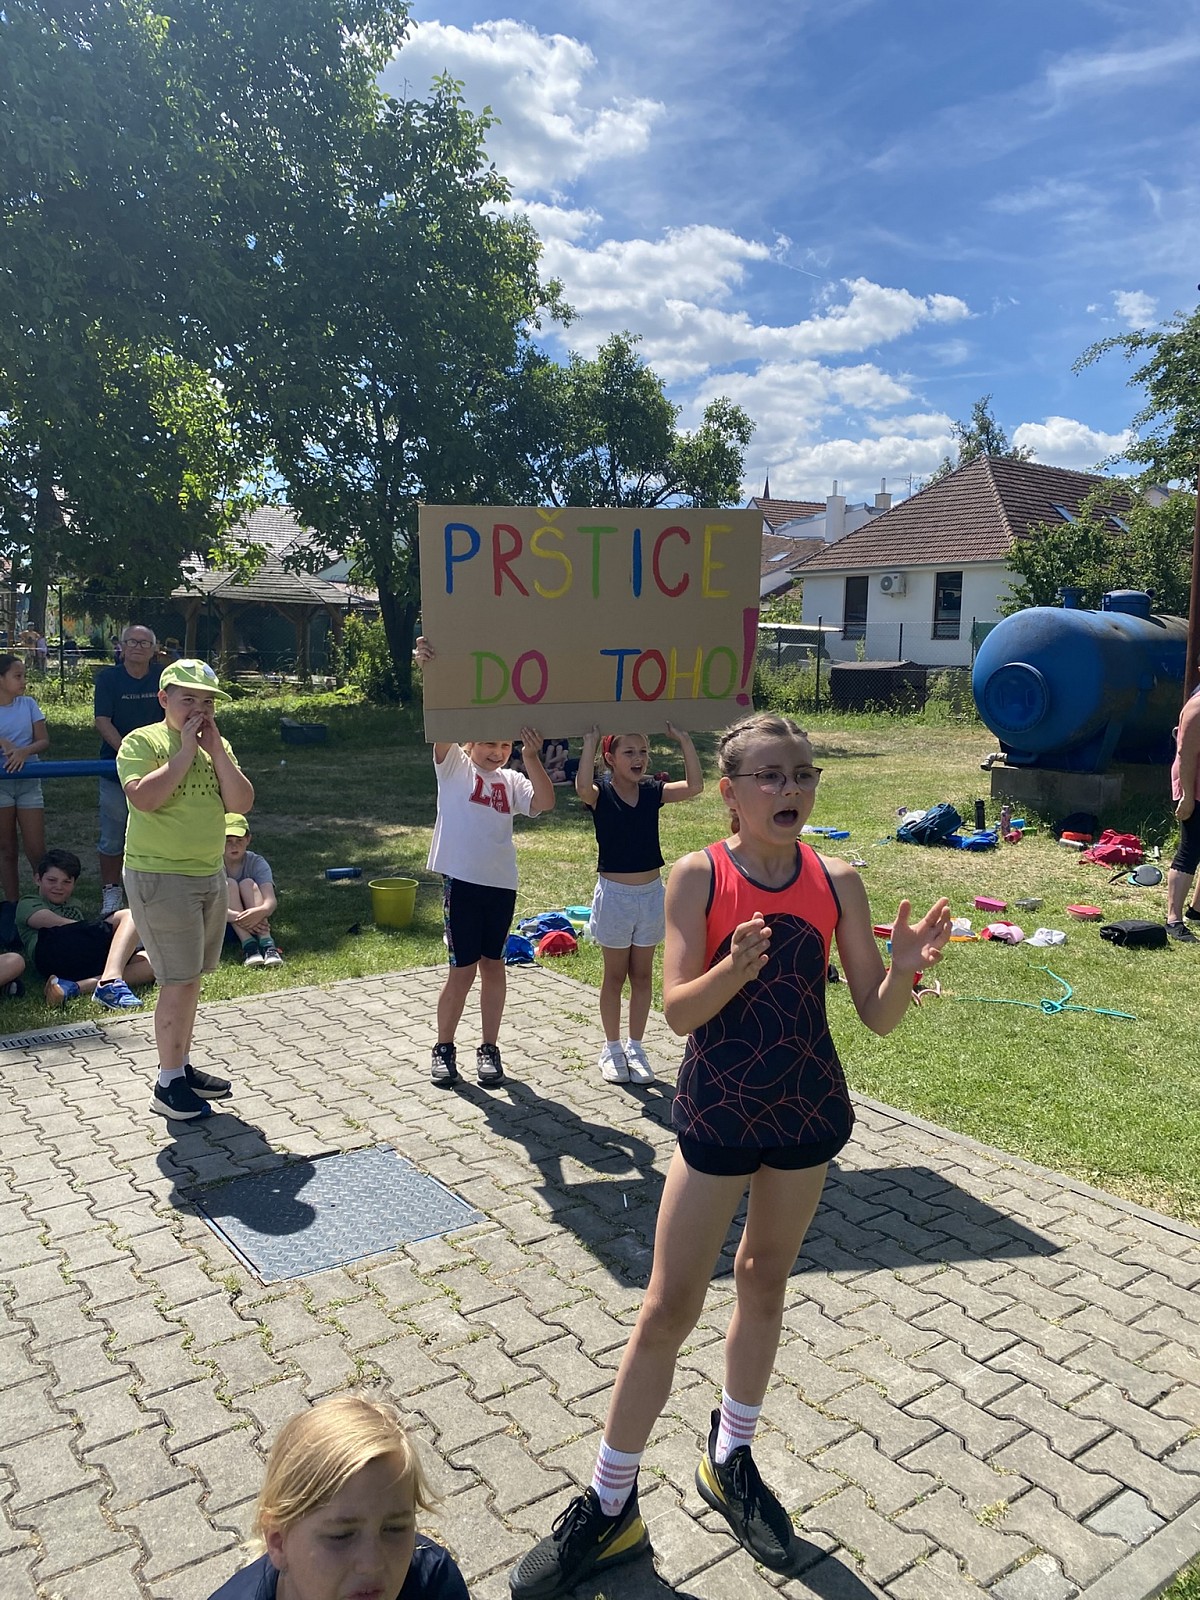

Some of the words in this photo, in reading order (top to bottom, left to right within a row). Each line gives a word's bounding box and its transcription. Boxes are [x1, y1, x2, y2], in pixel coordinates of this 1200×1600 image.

[444, 508, 733, 599] PRŠTICE
[470, 649, 549, 705] DO
[600, 607, 759, 706] TOHO!
[469, 773, 511, 814] LA
